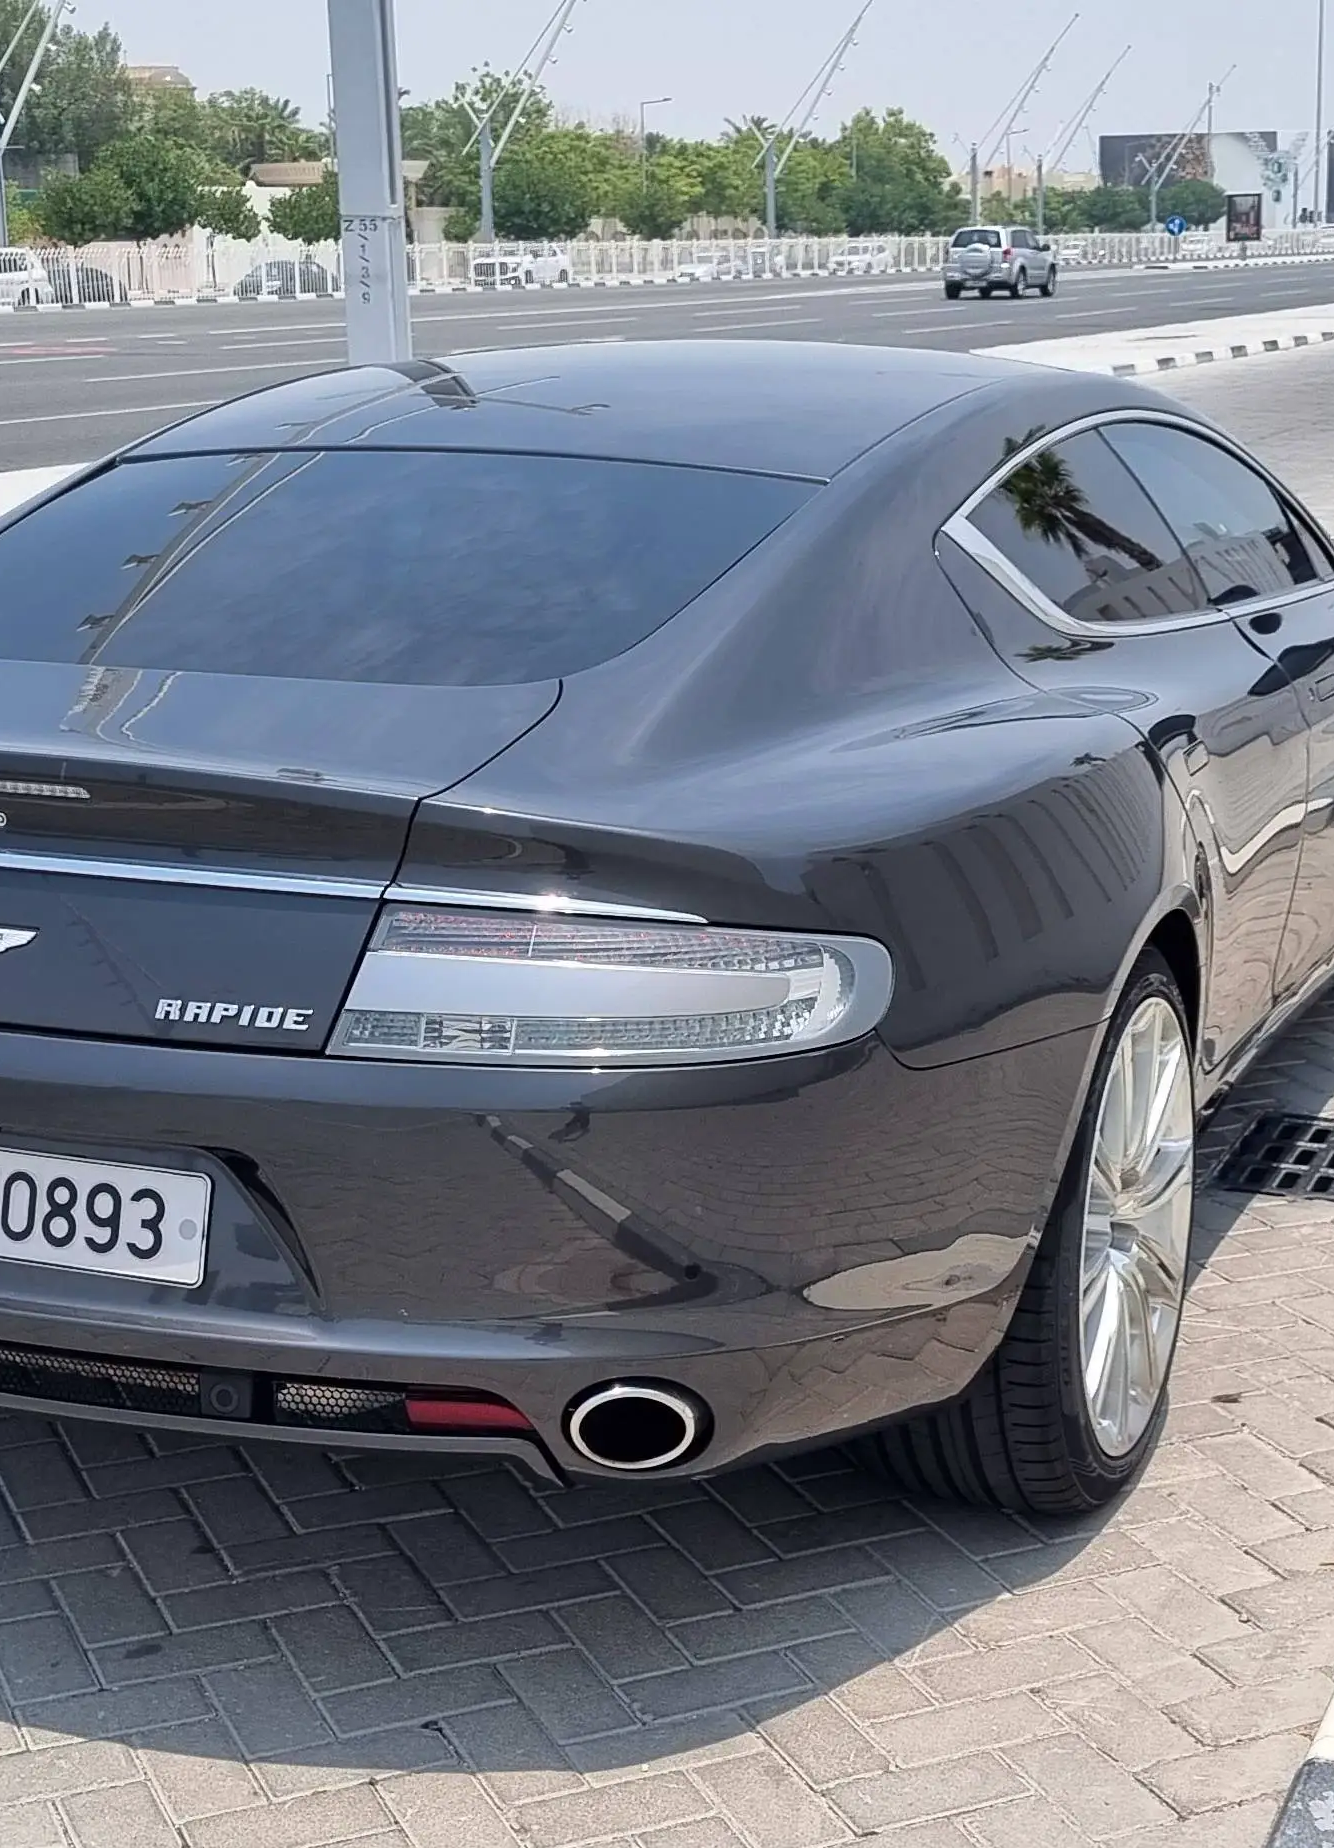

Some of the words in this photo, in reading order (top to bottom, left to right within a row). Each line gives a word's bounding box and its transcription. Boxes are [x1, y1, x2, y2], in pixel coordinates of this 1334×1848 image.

[343, 219, 355, 232] Z
[358, 218, 378, 232] 55
[154, 998, 315, 1031] RAPIDE
